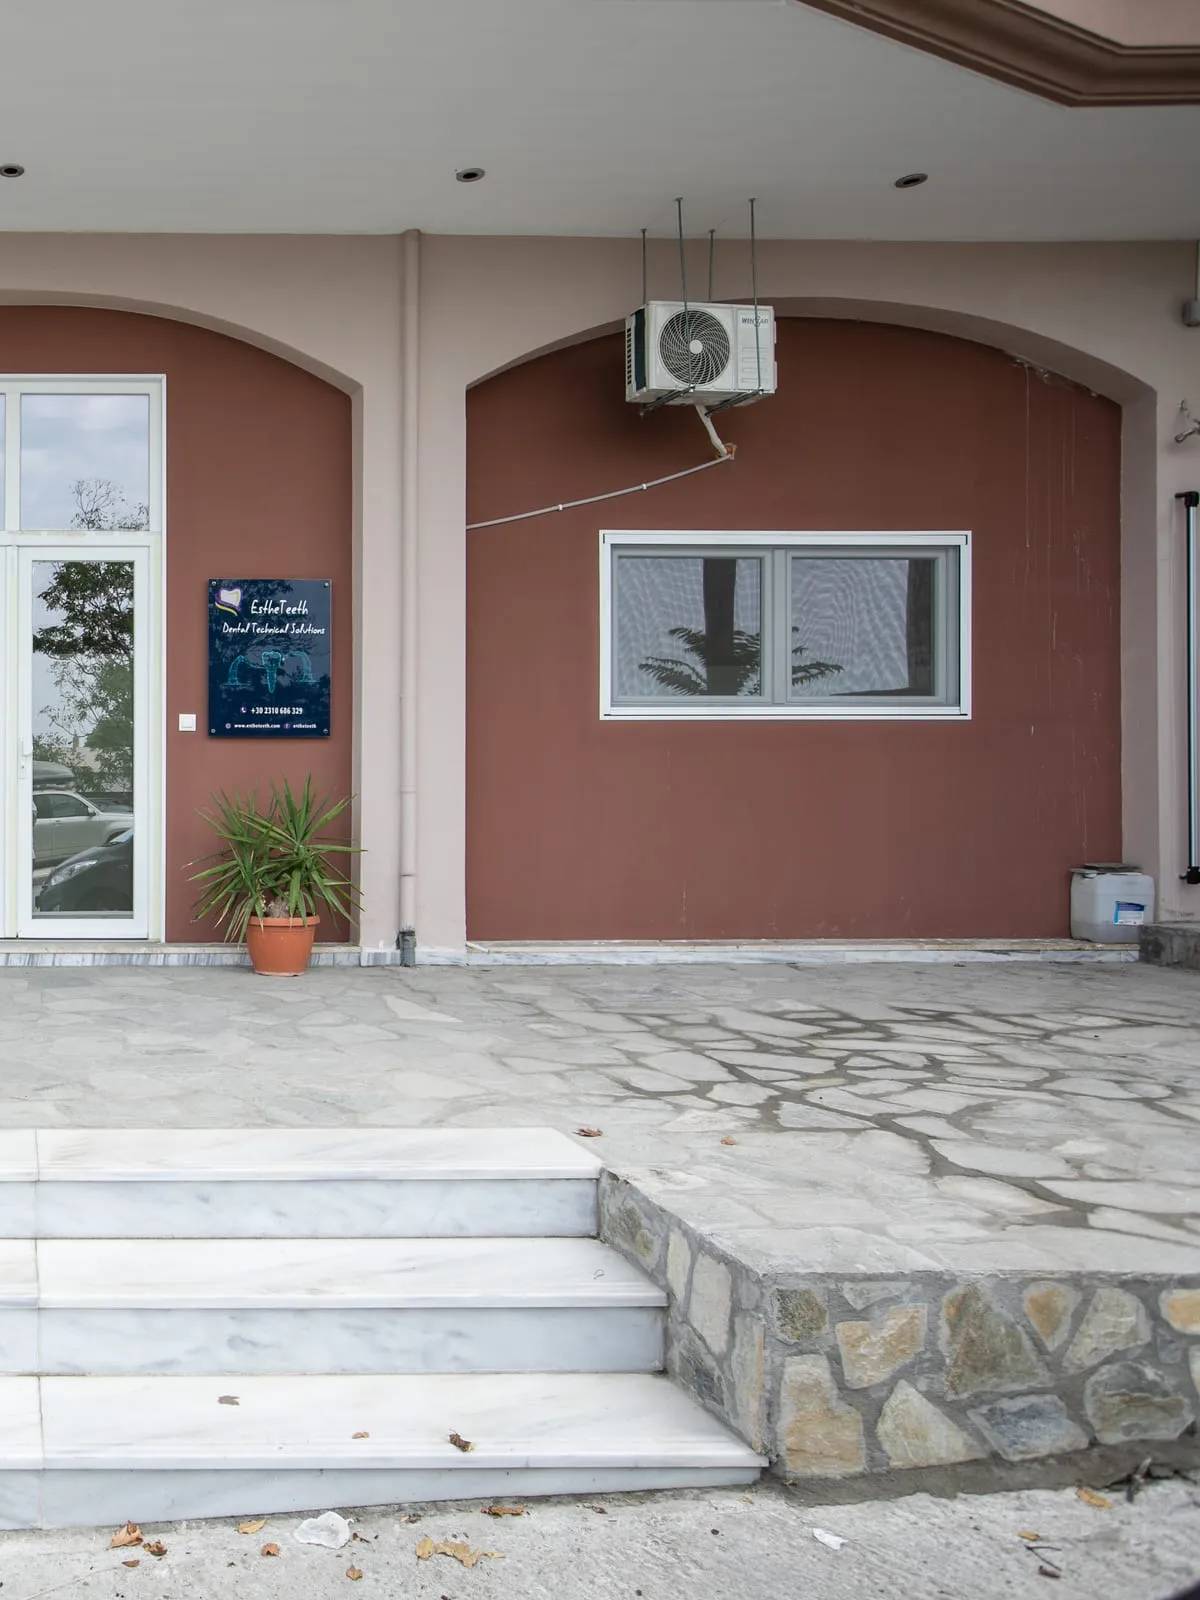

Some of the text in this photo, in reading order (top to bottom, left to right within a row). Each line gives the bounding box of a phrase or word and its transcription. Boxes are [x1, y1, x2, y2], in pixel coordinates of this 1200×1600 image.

[251, 599, 308, 614] EstheTeeth
[222, 622, 325, 634] Dental Technical Solutions
[251, 706, 263, 715] +30
[264, 706, 279, 715] 2310
[291, 707, 303, 715] 329
